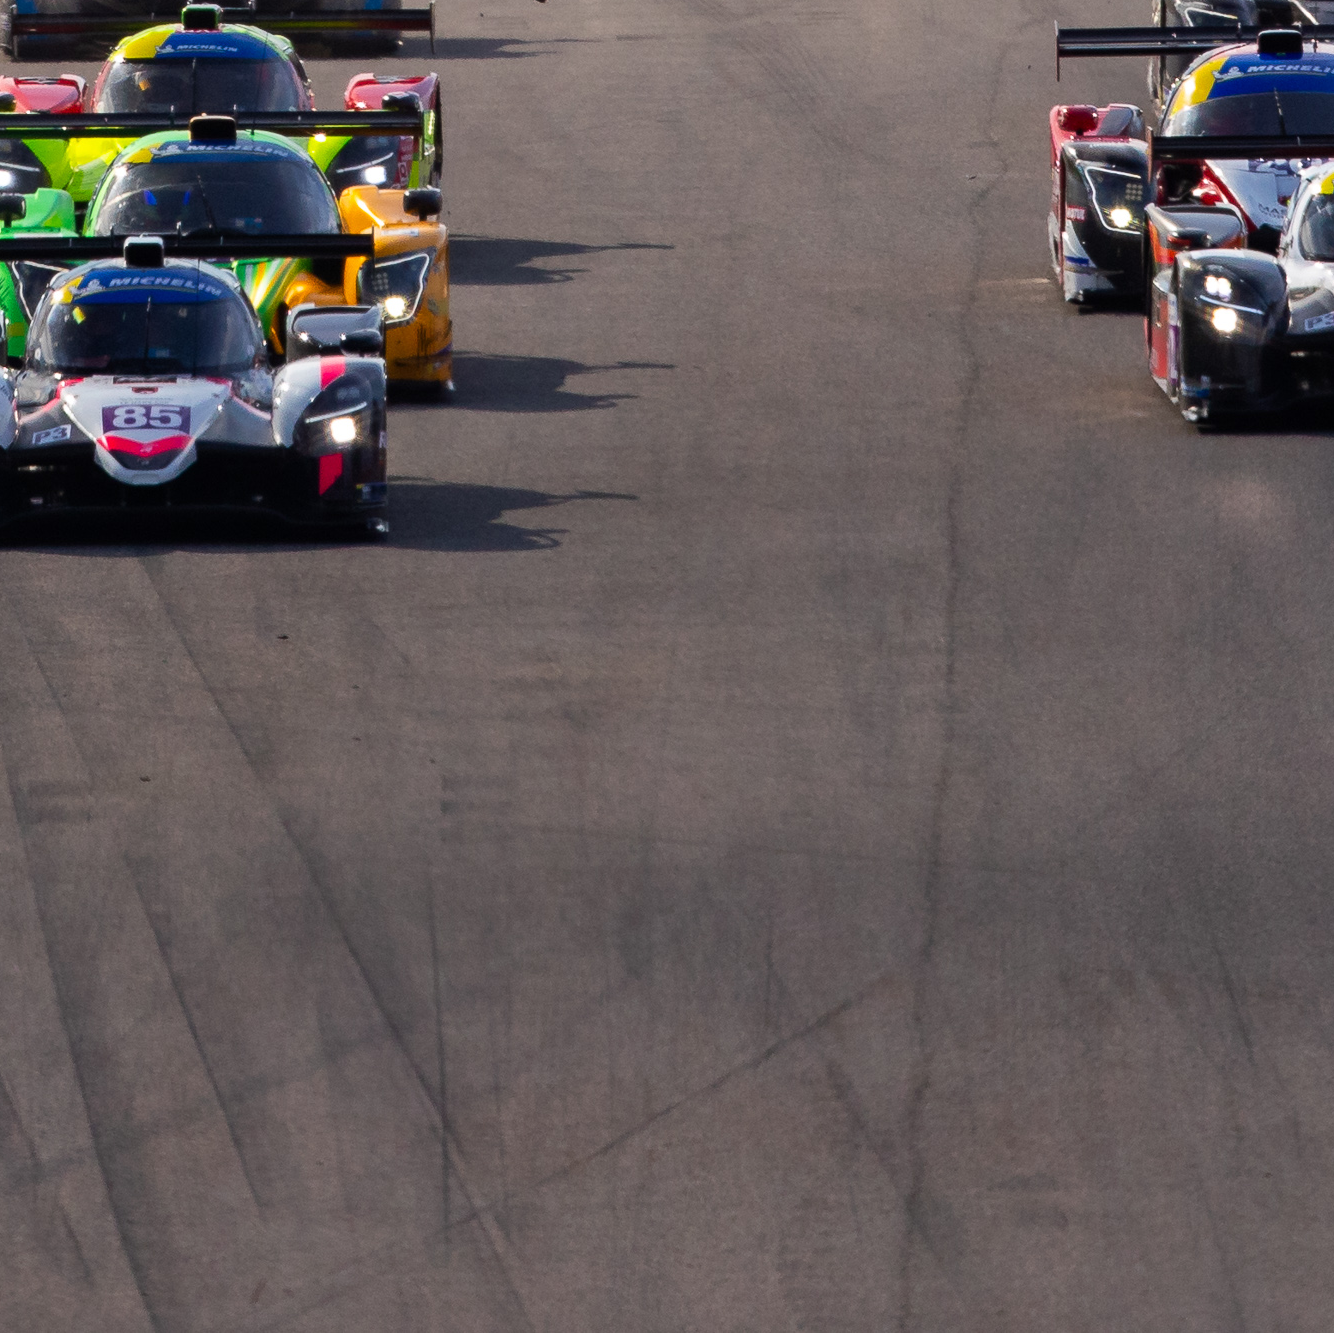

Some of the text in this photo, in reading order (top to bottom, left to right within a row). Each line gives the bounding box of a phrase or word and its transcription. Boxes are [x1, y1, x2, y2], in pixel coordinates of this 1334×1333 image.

[186, 144, 289, 158] MICHELIN
[109, 275, 223, 296] MICHELIN
[112, 406, 183, 429] 85
